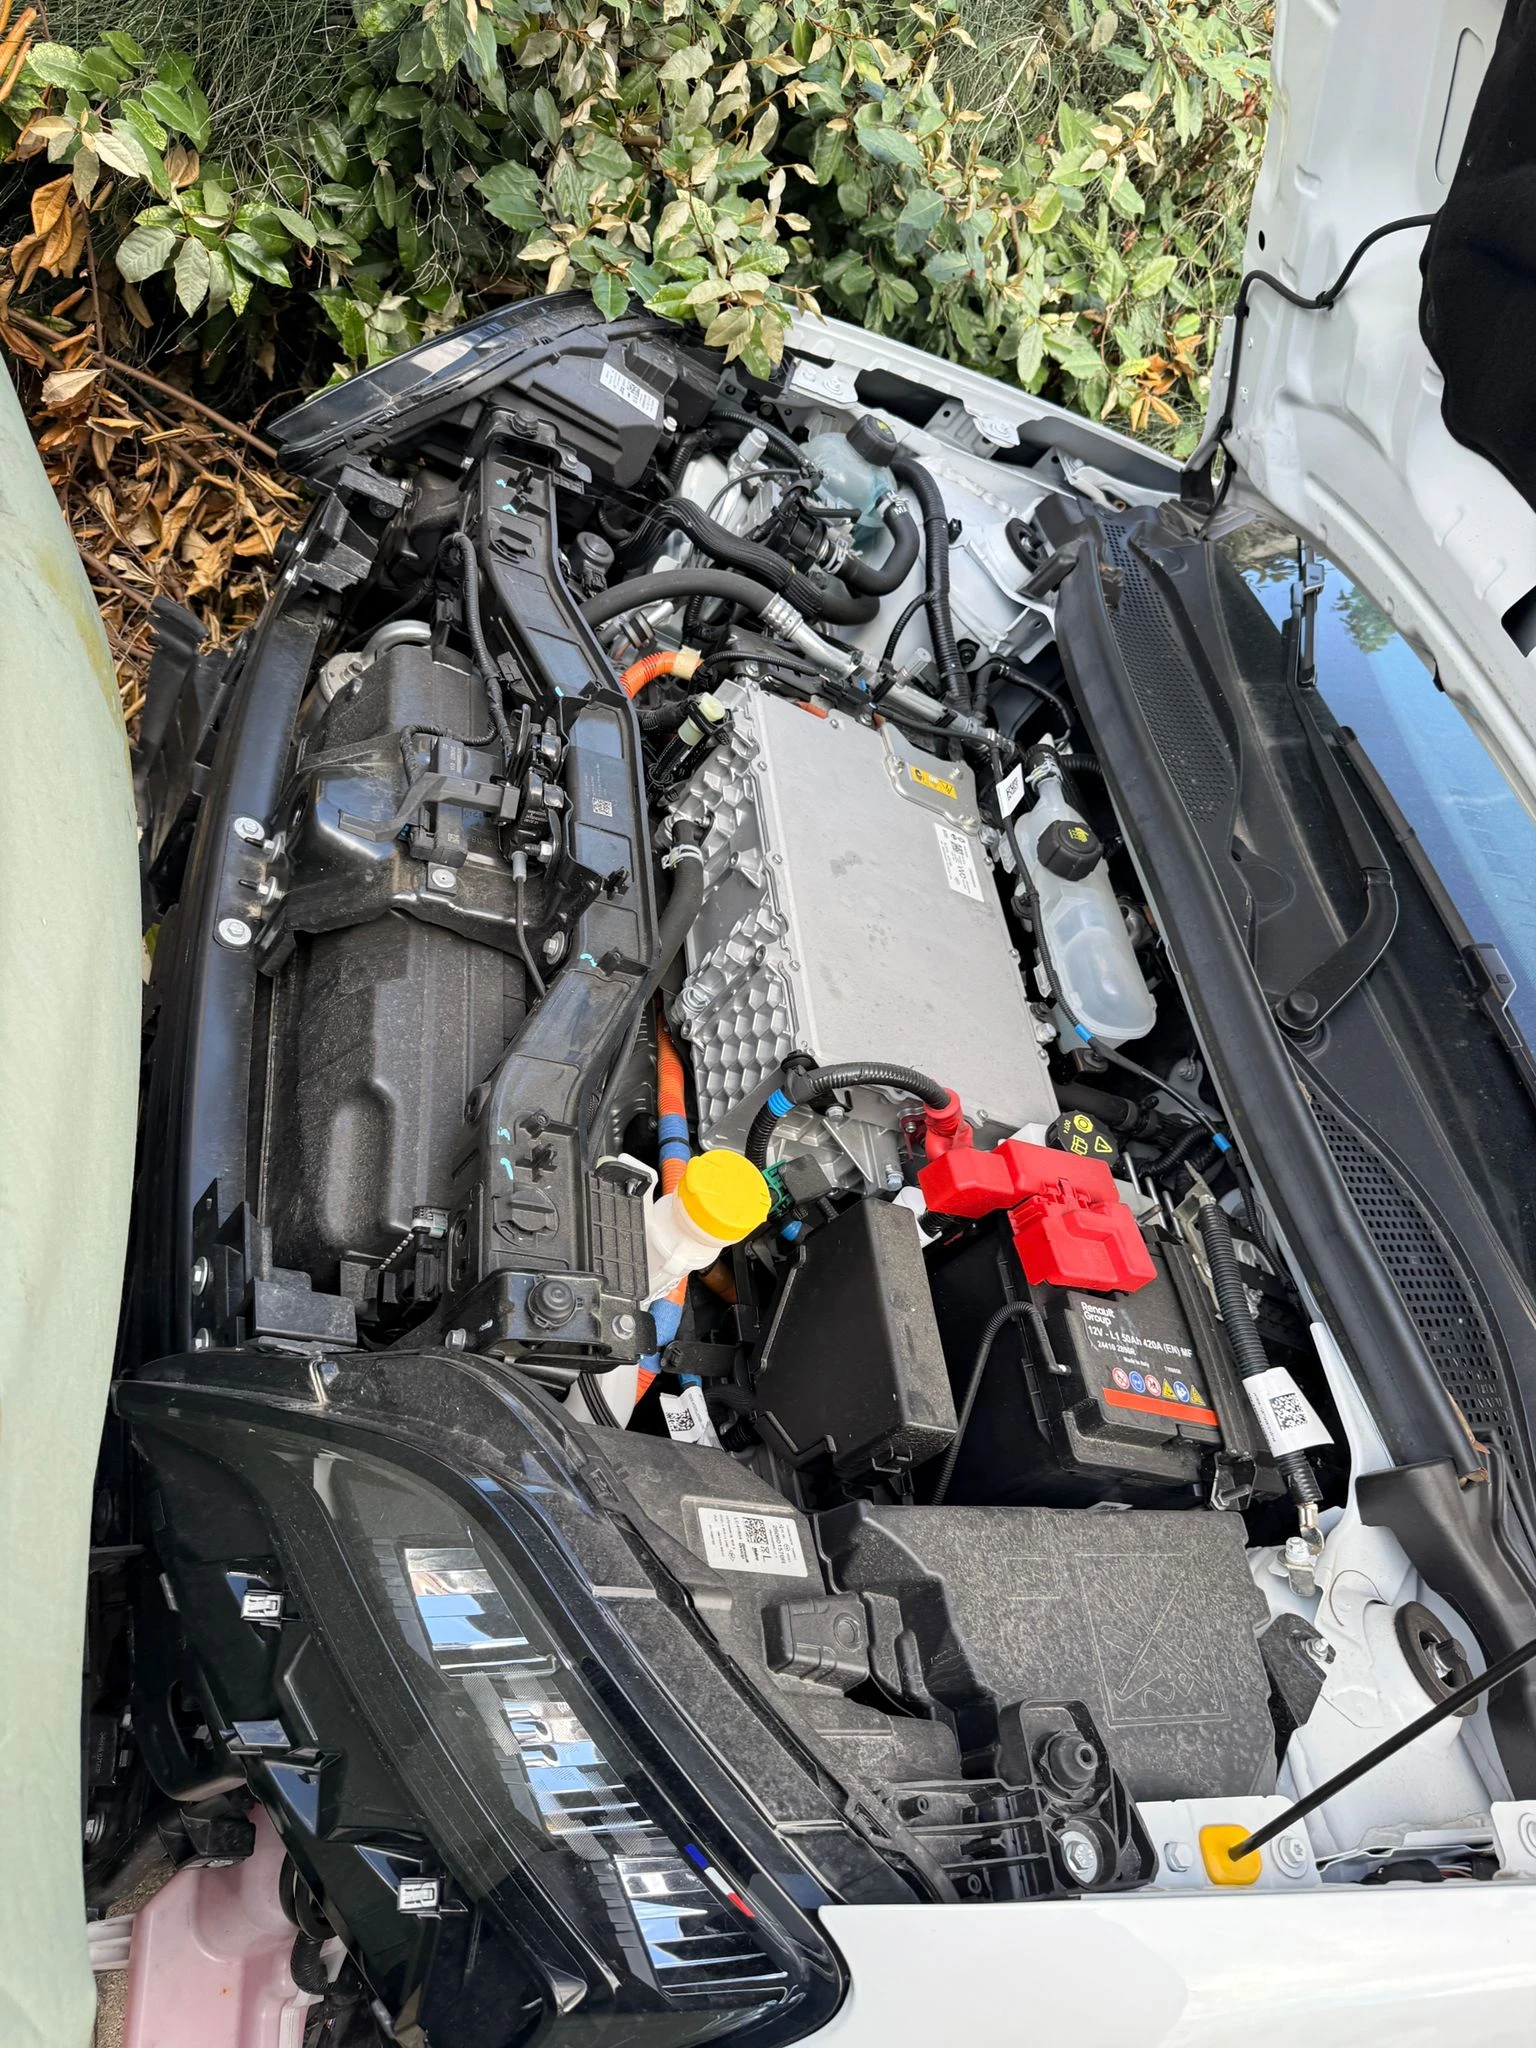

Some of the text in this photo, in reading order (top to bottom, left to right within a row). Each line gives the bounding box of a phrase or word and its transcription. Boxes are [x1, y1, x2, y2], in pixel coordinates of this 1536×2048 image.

[1081, 1301, 1115, 1318] Renault
[1084, 1310, 1111, 1327] Group
[1088, 1325, 1103, 1337] 12V
[1109, 1330, 1120, 1341] L1
[1121, 1333, 1142, 1346] 50Ah
[1143, 1338, 1163, 1351] 420A
[1163, 1343, 1181, 1357] (EN)
[1180, 1347, 1192, 1358] MF
